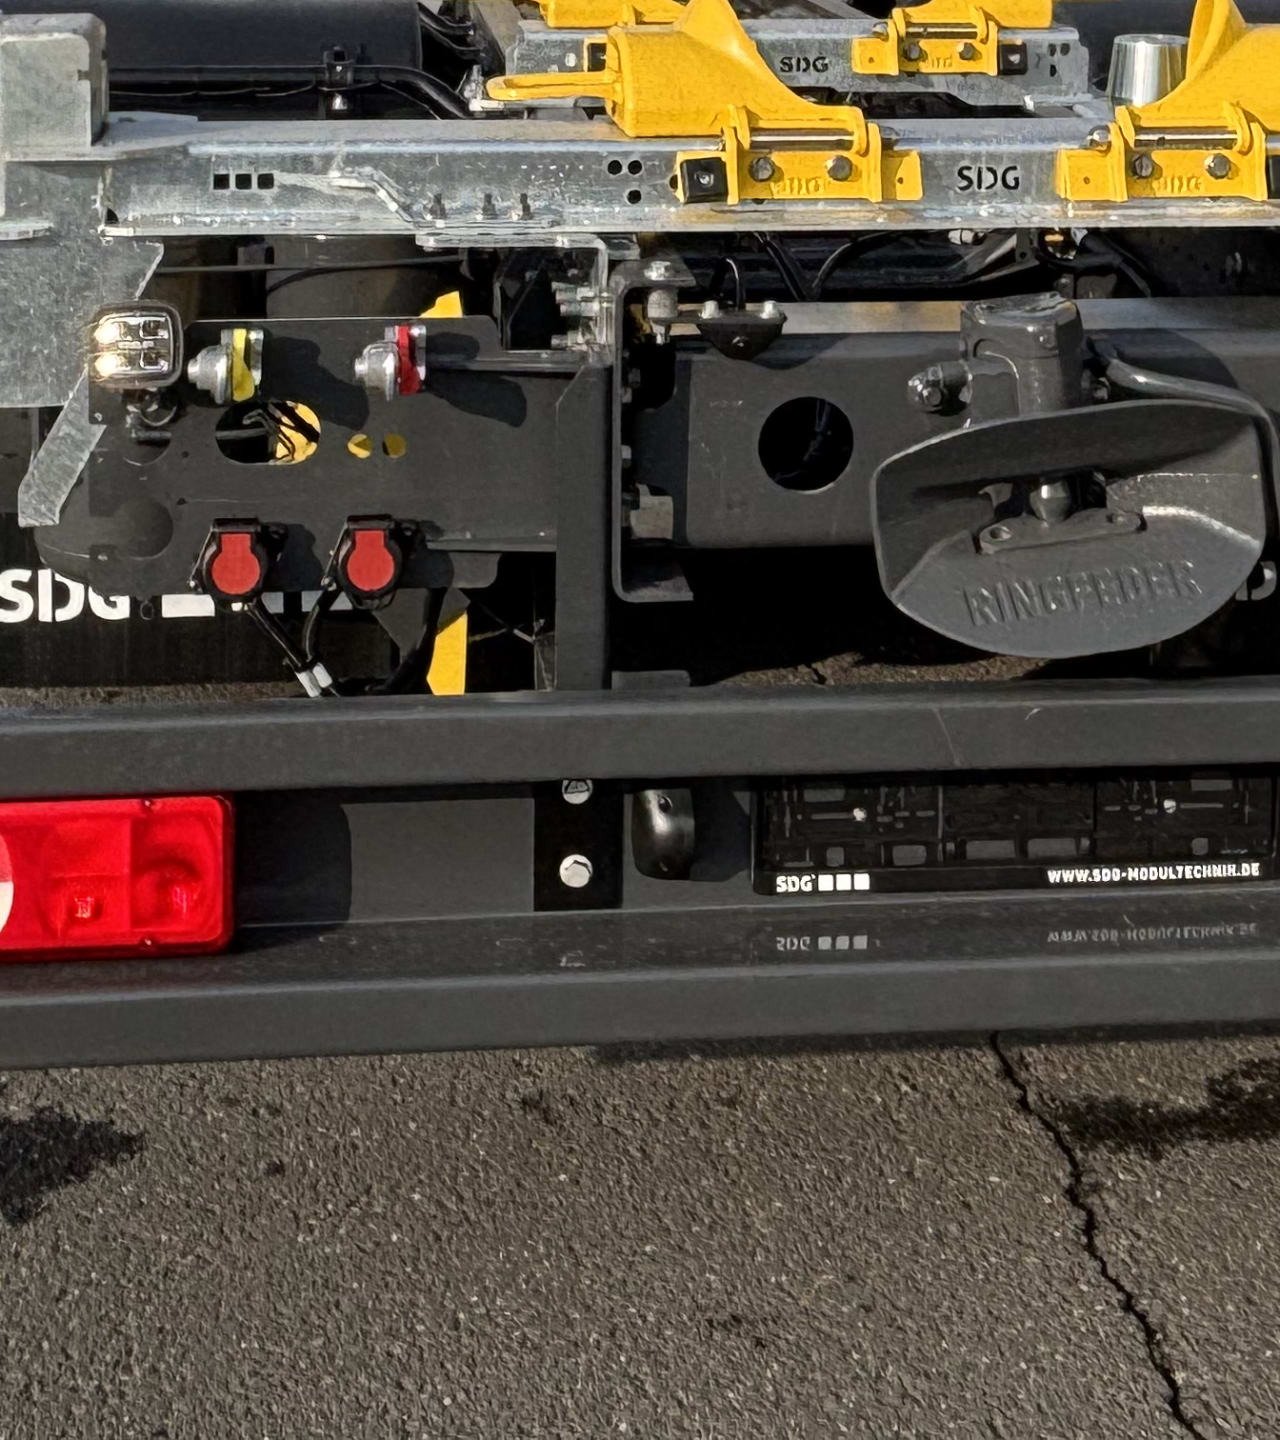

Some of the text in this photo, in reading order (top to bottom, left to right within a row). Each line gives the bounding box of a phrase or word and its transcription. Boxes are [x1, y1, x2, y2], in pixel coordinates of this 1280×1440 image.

[779, 56, 829, 73] SDG
[956, 164, 1021, 192] SDG
[961, 560, 1203, 627] RINGFEDER
[776, 874, 814, 893] SDG
